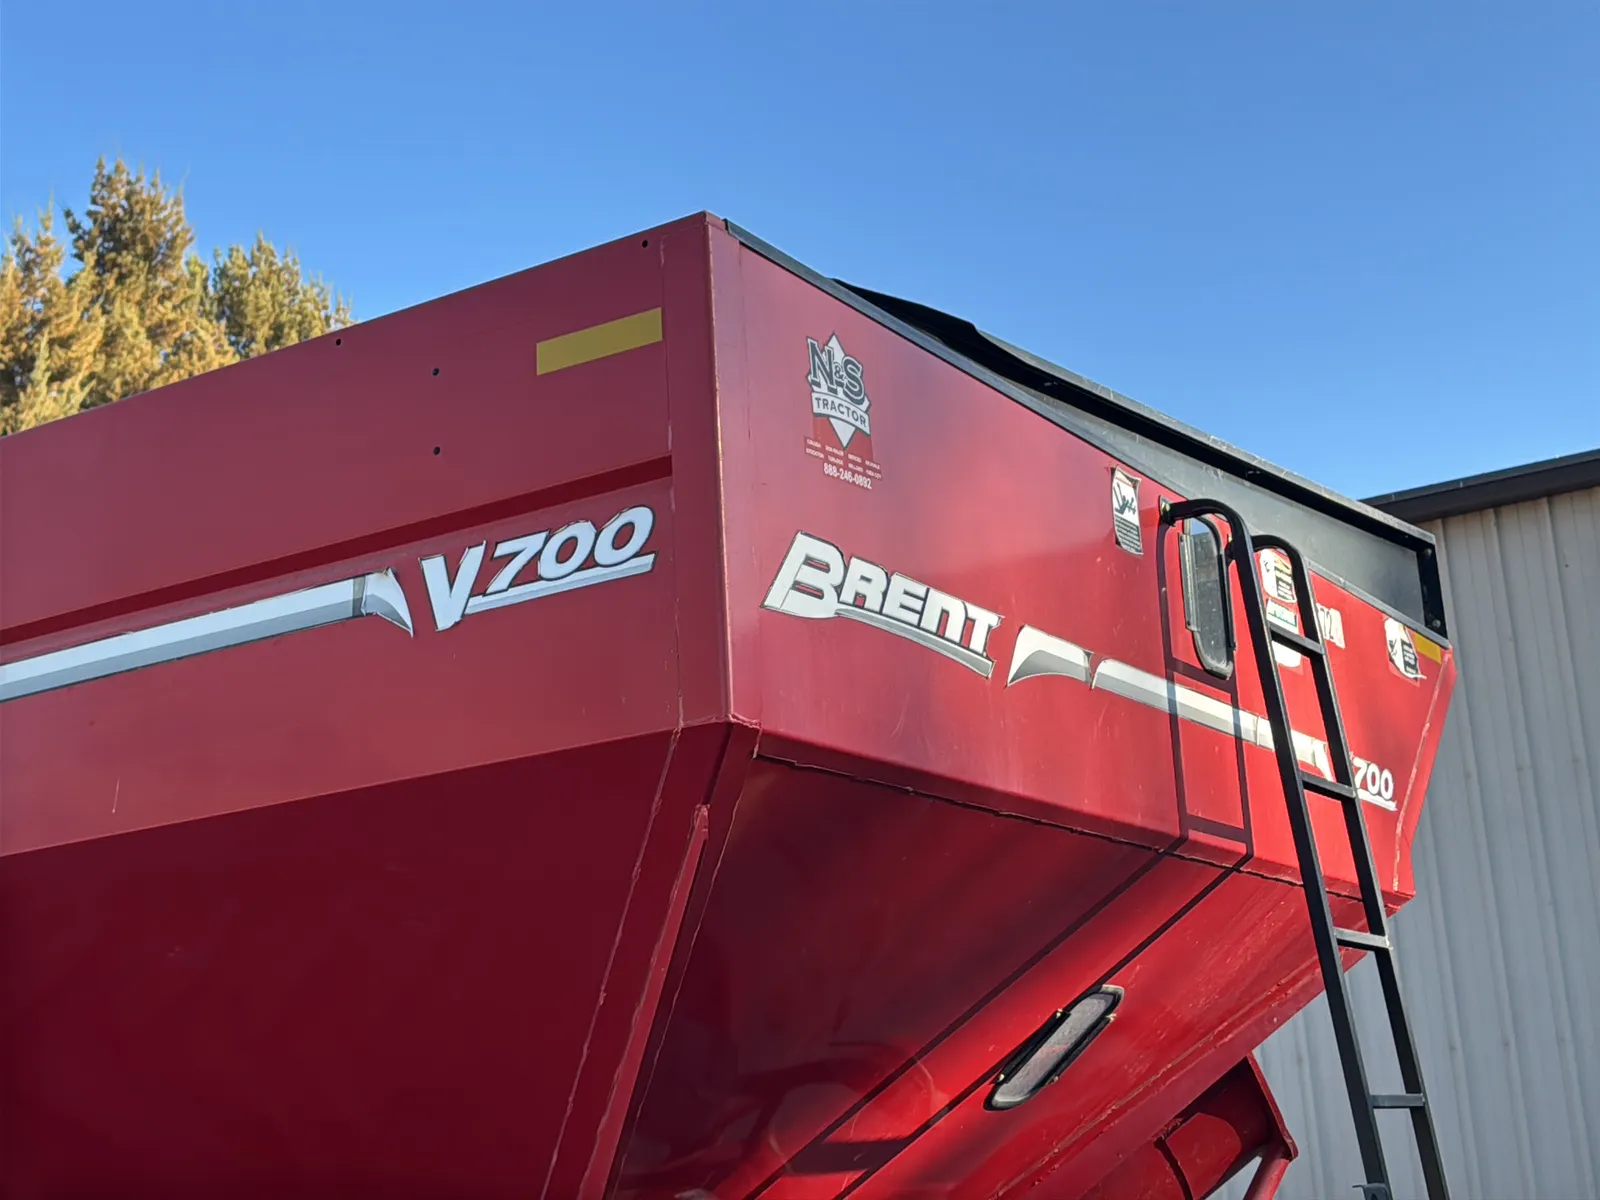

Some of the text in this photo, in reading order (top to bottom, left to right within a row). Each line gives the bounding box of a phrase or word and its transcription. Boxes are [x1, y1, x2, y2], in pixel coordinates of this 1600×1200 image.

[807, 337, 864, 404] N&S
[815, 397, 867, 428] TRACTOR
[418, 505, 656, 632] V700
[1349, 753, 1395, 801] 700
